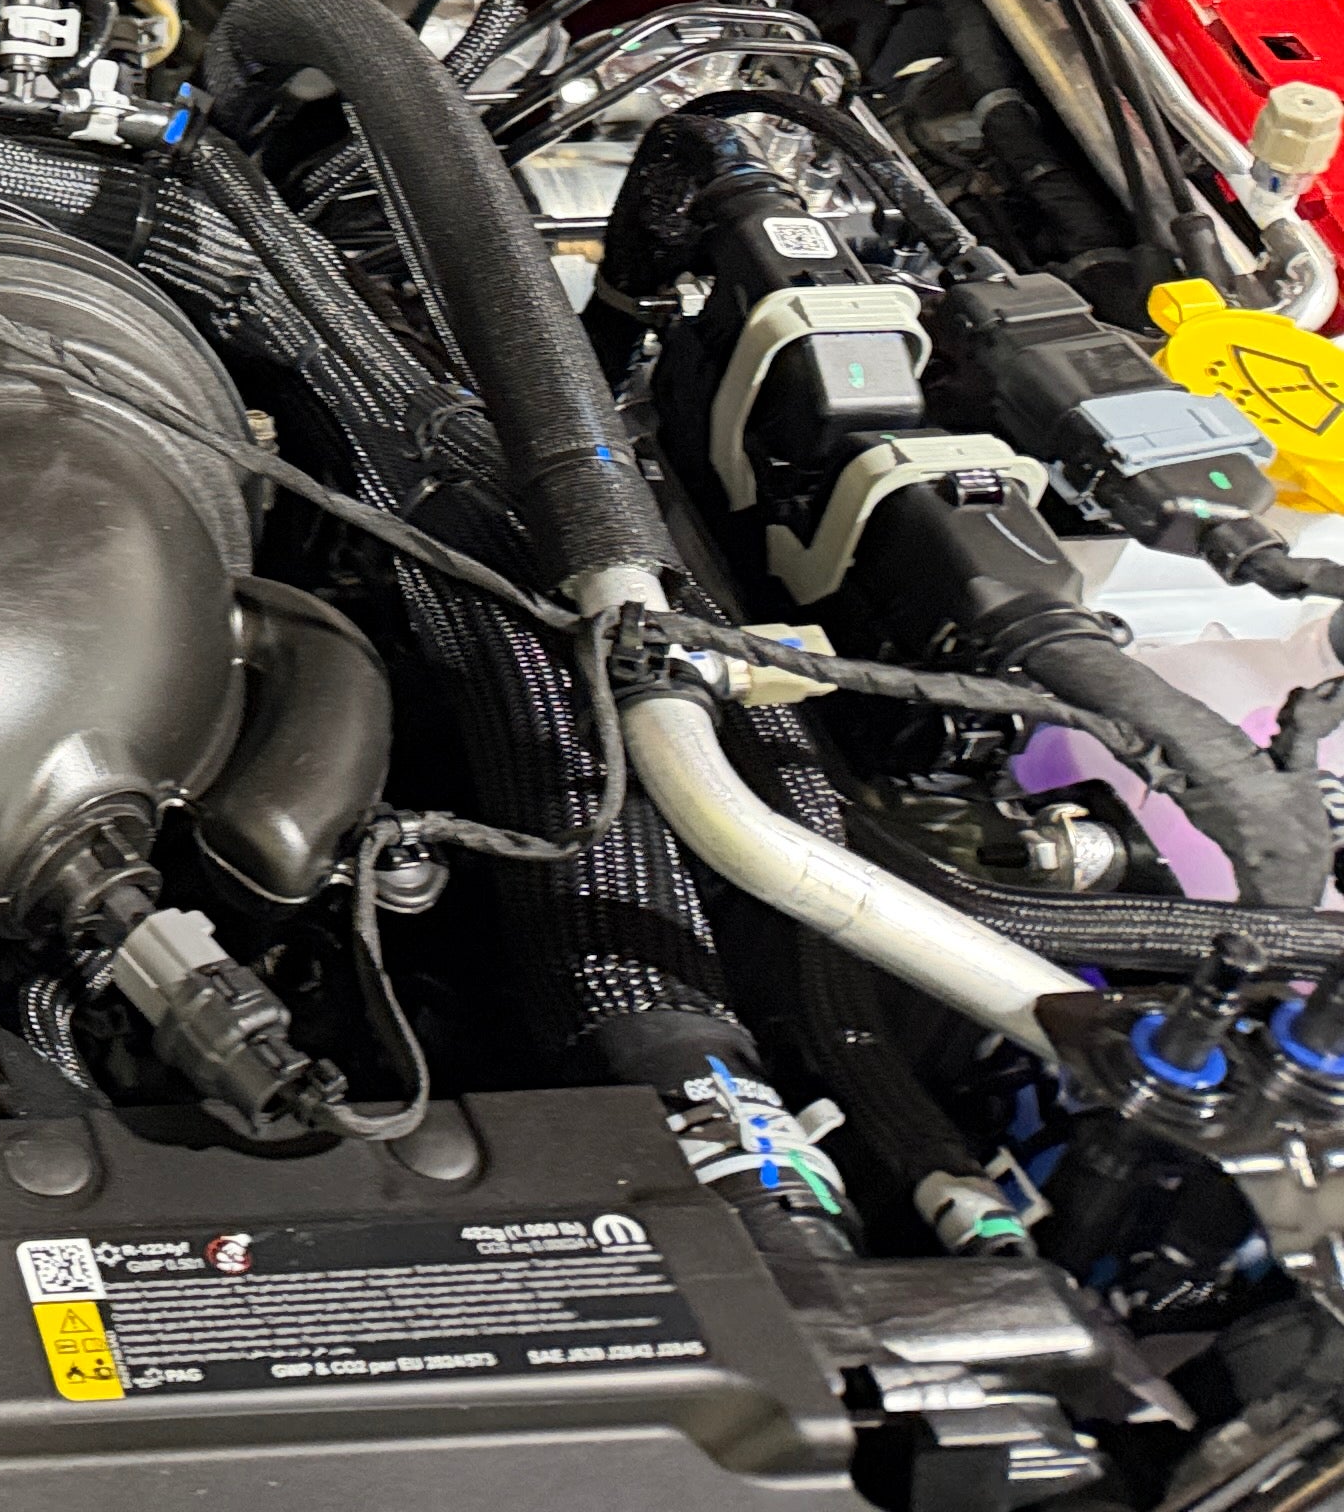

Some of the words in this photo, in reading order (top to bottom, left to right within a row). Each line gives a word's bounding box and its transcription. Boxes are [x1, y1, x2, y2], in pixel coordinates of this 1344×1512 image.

[164, 1368, 205, 1383] PAG
[271, 1362, 313, 1378] GWP
[330, 1360, 369, 1375] CO2
